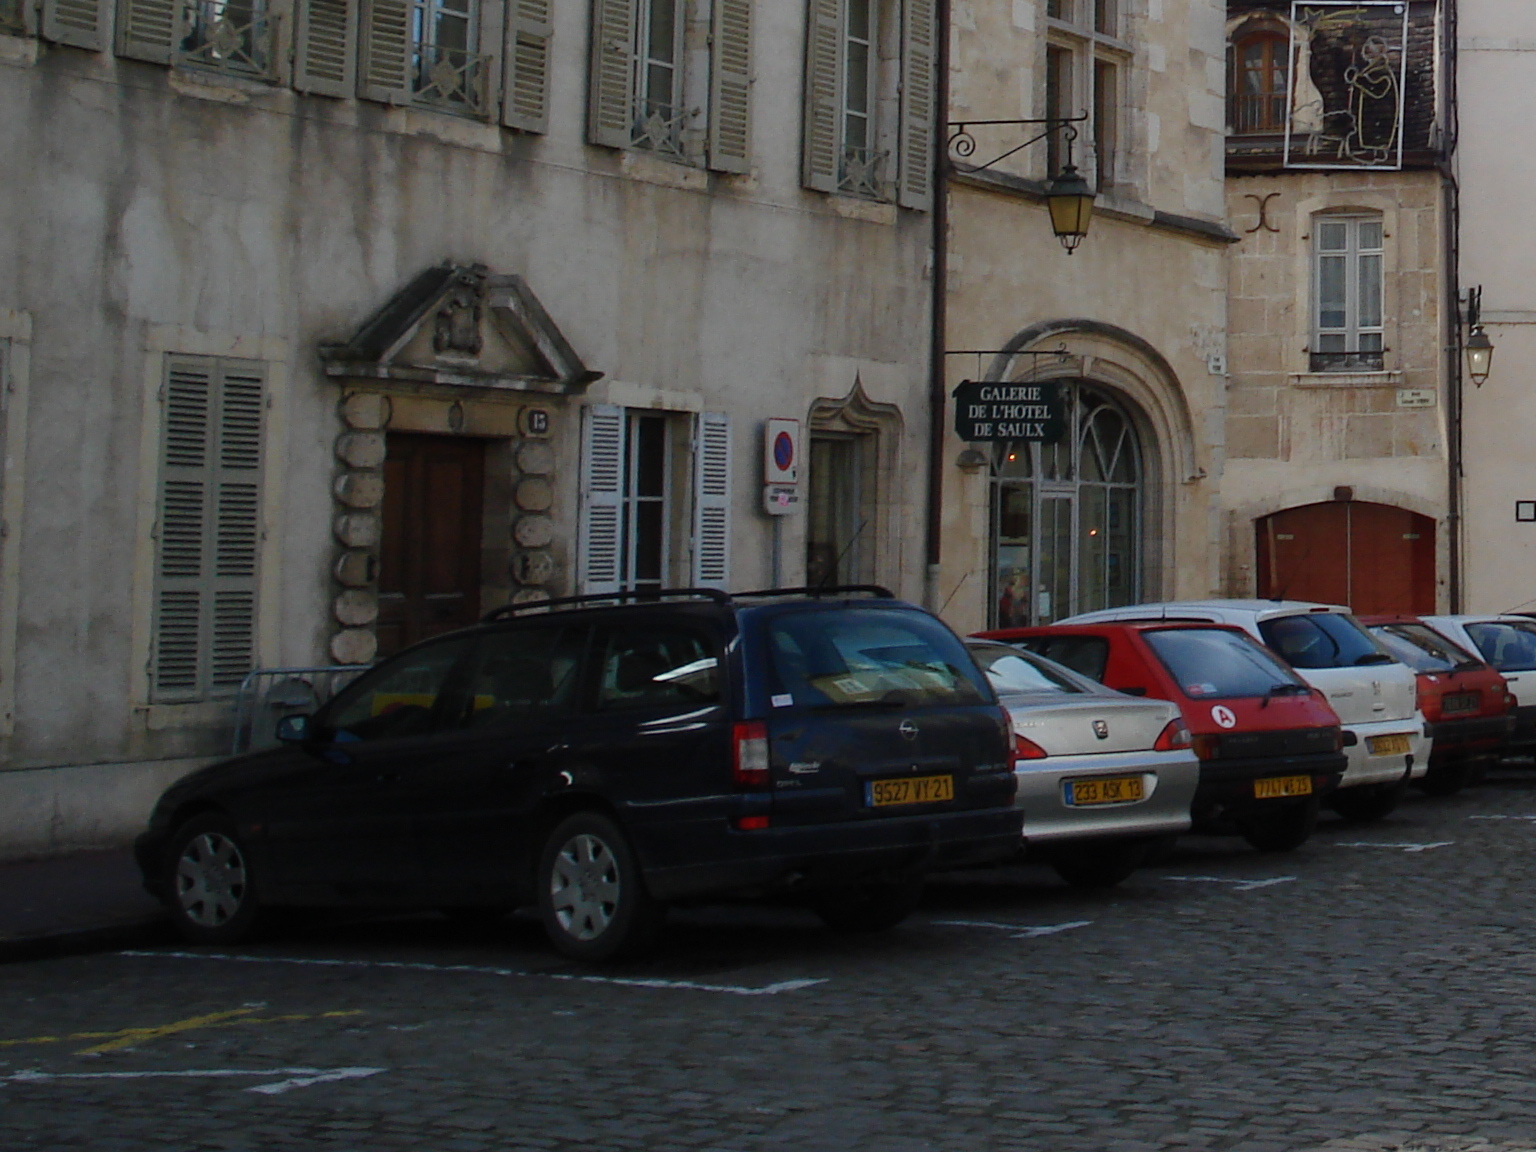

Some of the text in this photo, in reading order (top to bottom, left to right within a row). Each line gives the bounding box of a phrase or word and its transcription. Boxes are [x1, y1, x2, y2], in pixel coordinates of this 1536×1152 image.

[980, 387, 1041, 401] GALERIE
[968, 405, 987, 418] DE
[974, 423, 1045, 437] DE SAULX
[873, 781, 909, 804] 9527
[1075, 779, 1141, 801] 233 ASK 13
